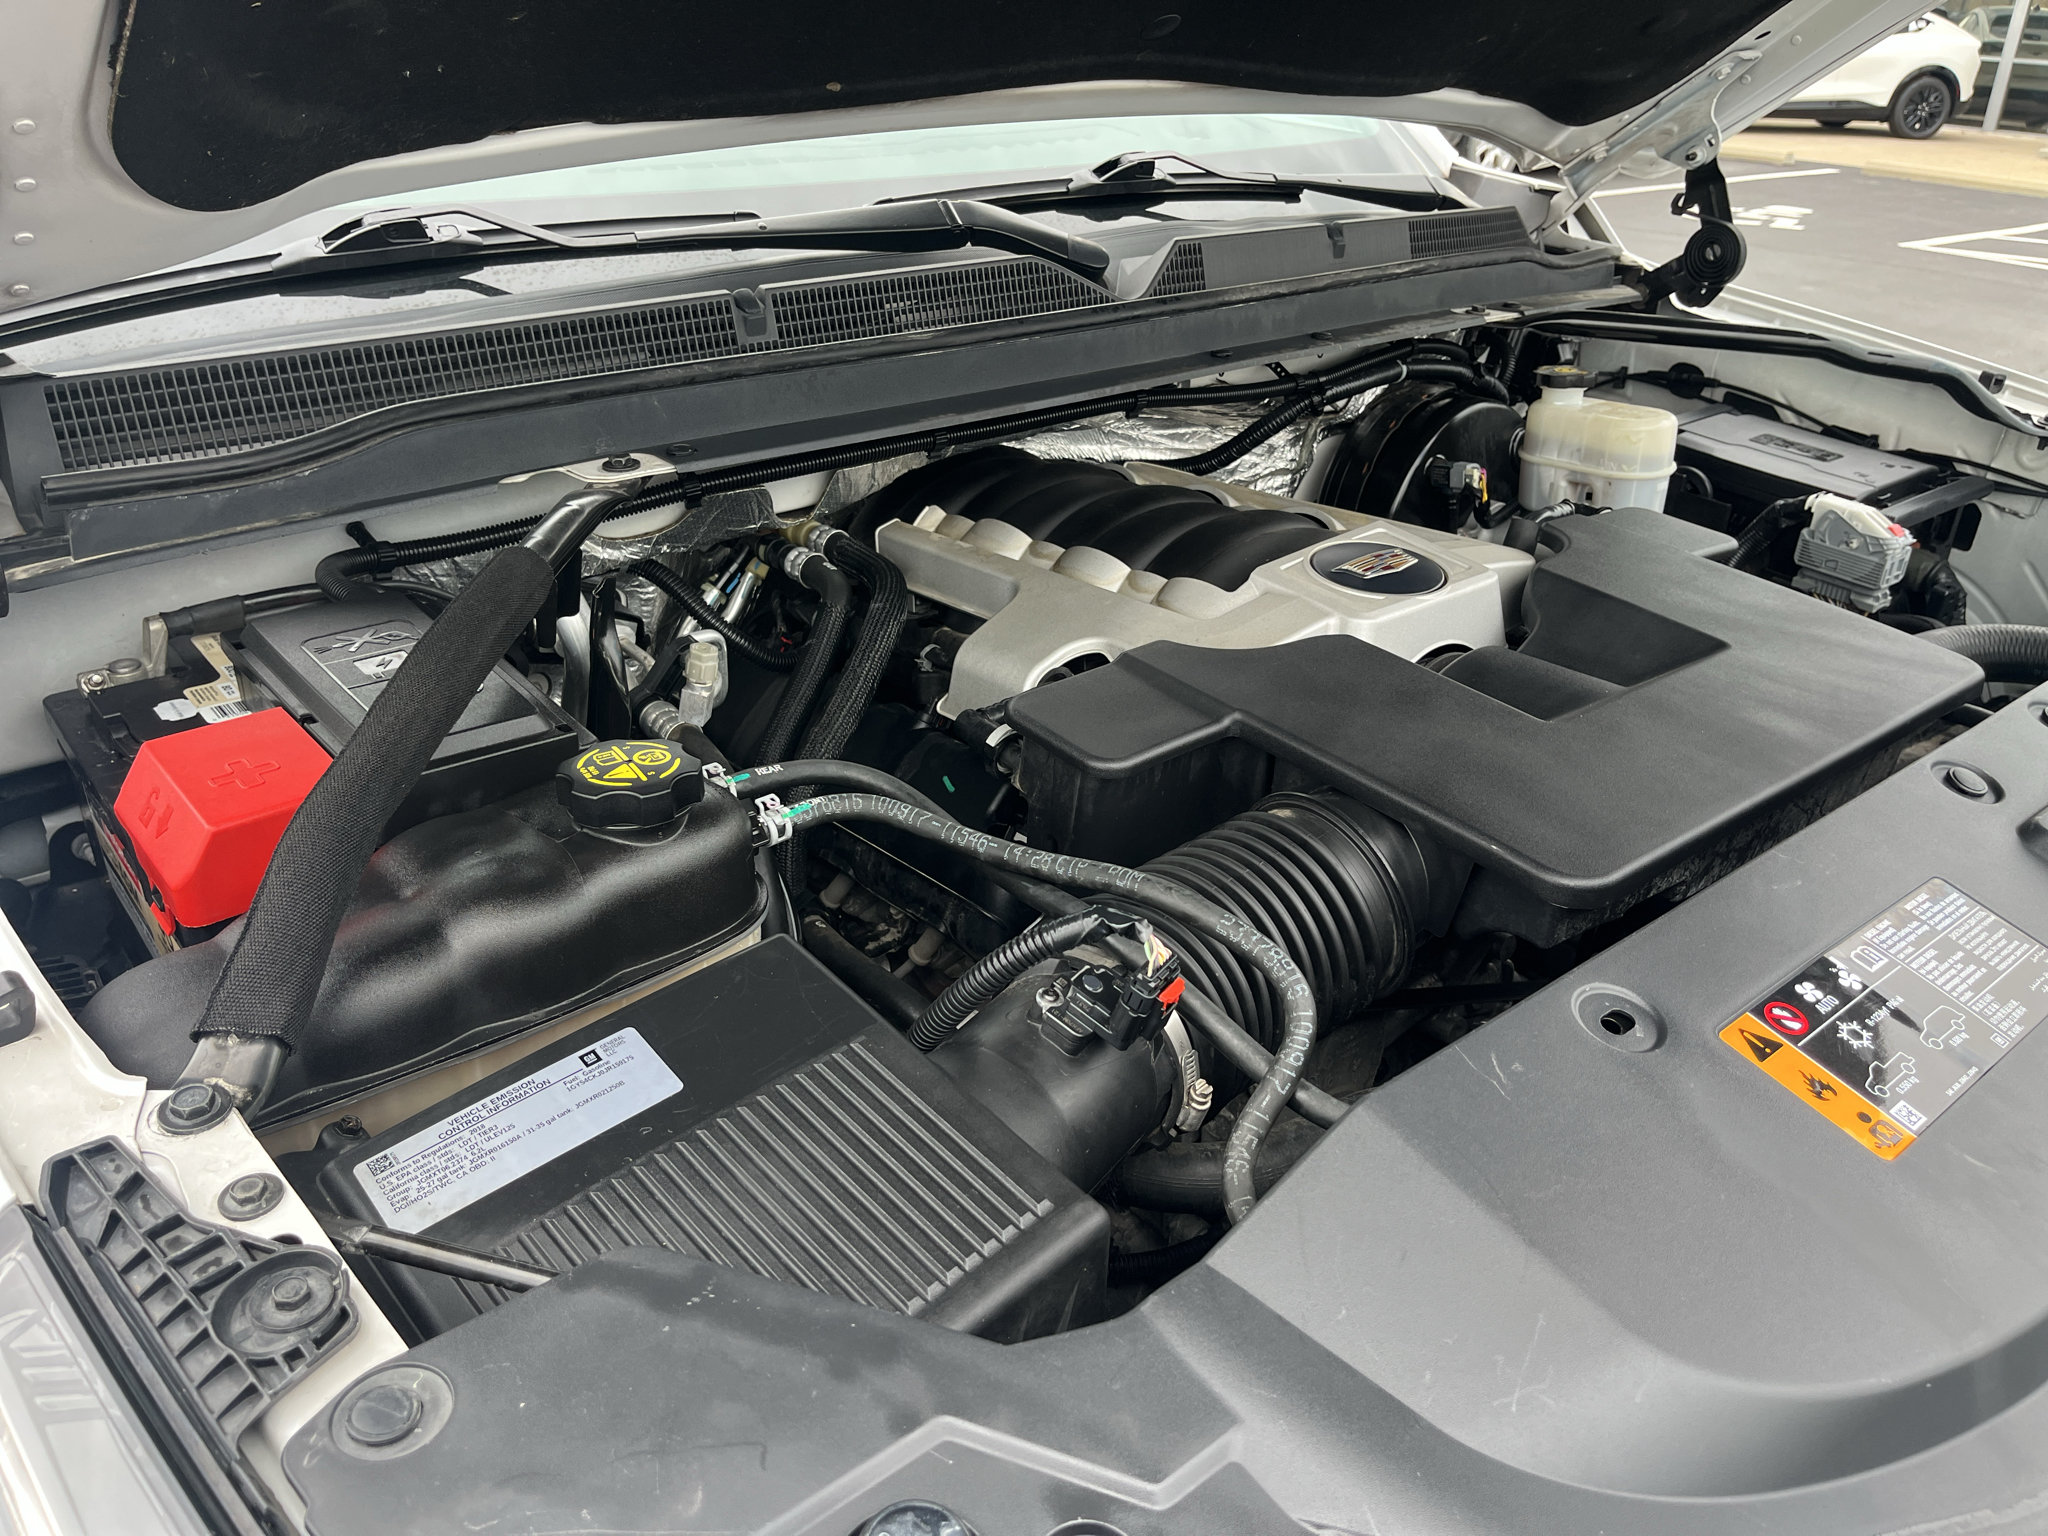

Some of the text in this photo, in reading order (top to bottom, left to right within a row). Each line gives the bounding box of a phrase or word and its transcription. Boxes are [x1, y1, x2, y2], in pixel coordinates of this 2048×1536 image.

[755, 764, 784, 776] REAR
[1815, 996, 1840, 1014] AUTO
[599, 1034, 625, 1049] GENERAL
[602, 1039, 626, 1053] MOTORS
[605, 1048, 617, 1056] LLC
[581, 1058, 611, 1076] Gasoline
[437, 1078, 551, 1140] CONTROL INFORMATION
[447, 1078, 535, 1126] VEHICLE EMISSION
[374, 1162, 411, 1184] Conforms
[411, 1157, 420, 1165] to
[420, 1133, 466, 1161] Regulations:
[468, 1123, 486, 1135] 2018
[382, 1173, 419, 1196] California
[418, 1163, 439, 1176] class
[464, 1141, 480, 1152] LDT
[483, 1122, 516, 1142] ULEV125
[395, 1170, 412, 1181] EPA
[411, 1159, 432, 1172] class
[457, 1137, 473, 1148] LDT
[477, 1124, 498, 1138] TIER3
[415, 1179, 436, 1193] 25-27
[435, 1173, 449, 1183] gal
[525, 1121, 545, 1134] 31-35
[544, 1115, 557, 1125] gal
[386, 1184, 413, 1202] Group:
[470, 1145, 486, 1156] 6.2L
[455, 1170, 468, 1179] CA
